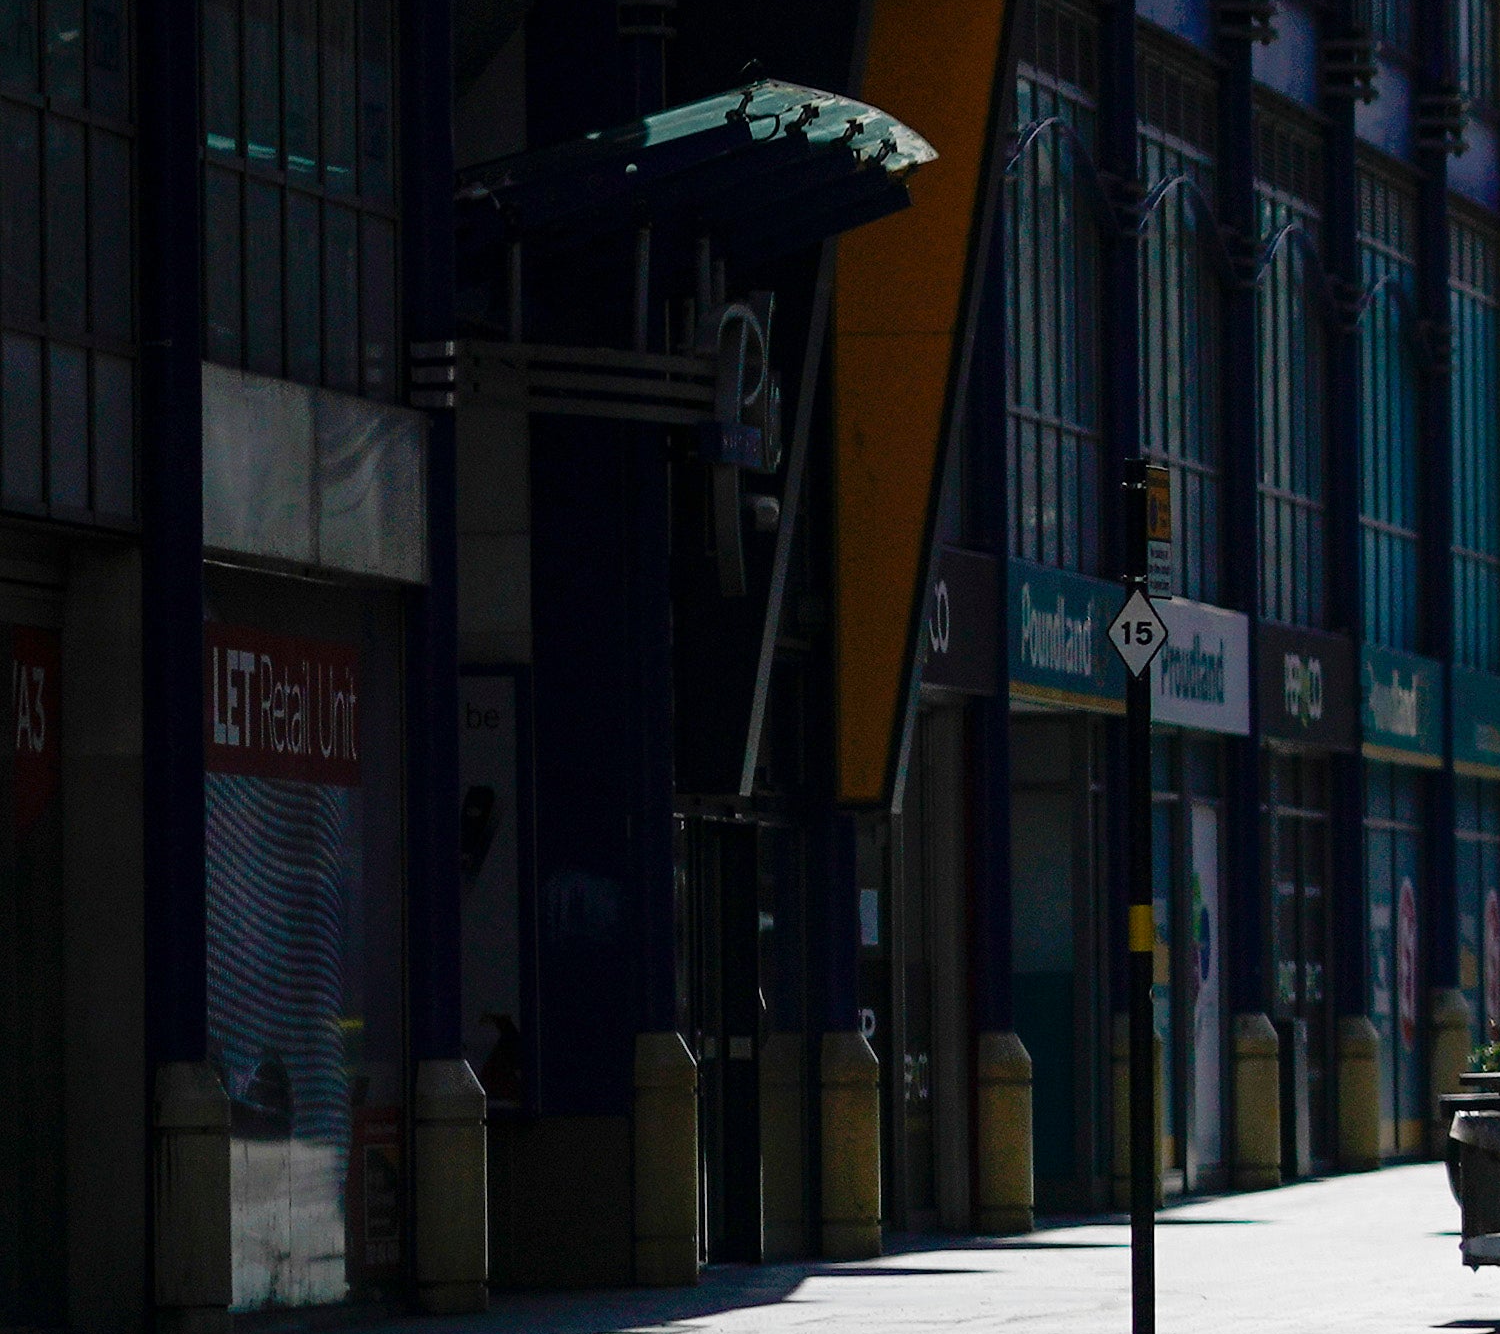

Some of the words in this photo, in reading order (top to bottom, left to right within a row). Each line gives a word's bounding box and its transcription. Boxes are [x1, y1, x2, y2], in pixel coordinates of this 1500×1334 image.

[1020, 581, 1094, 679] Poundland
[1121, 621, 1153, 646] 15
[213, 646, 255, 749] LET
[260, 653, 313, 757] Retail
[318, 660, 358, 763] Unit
